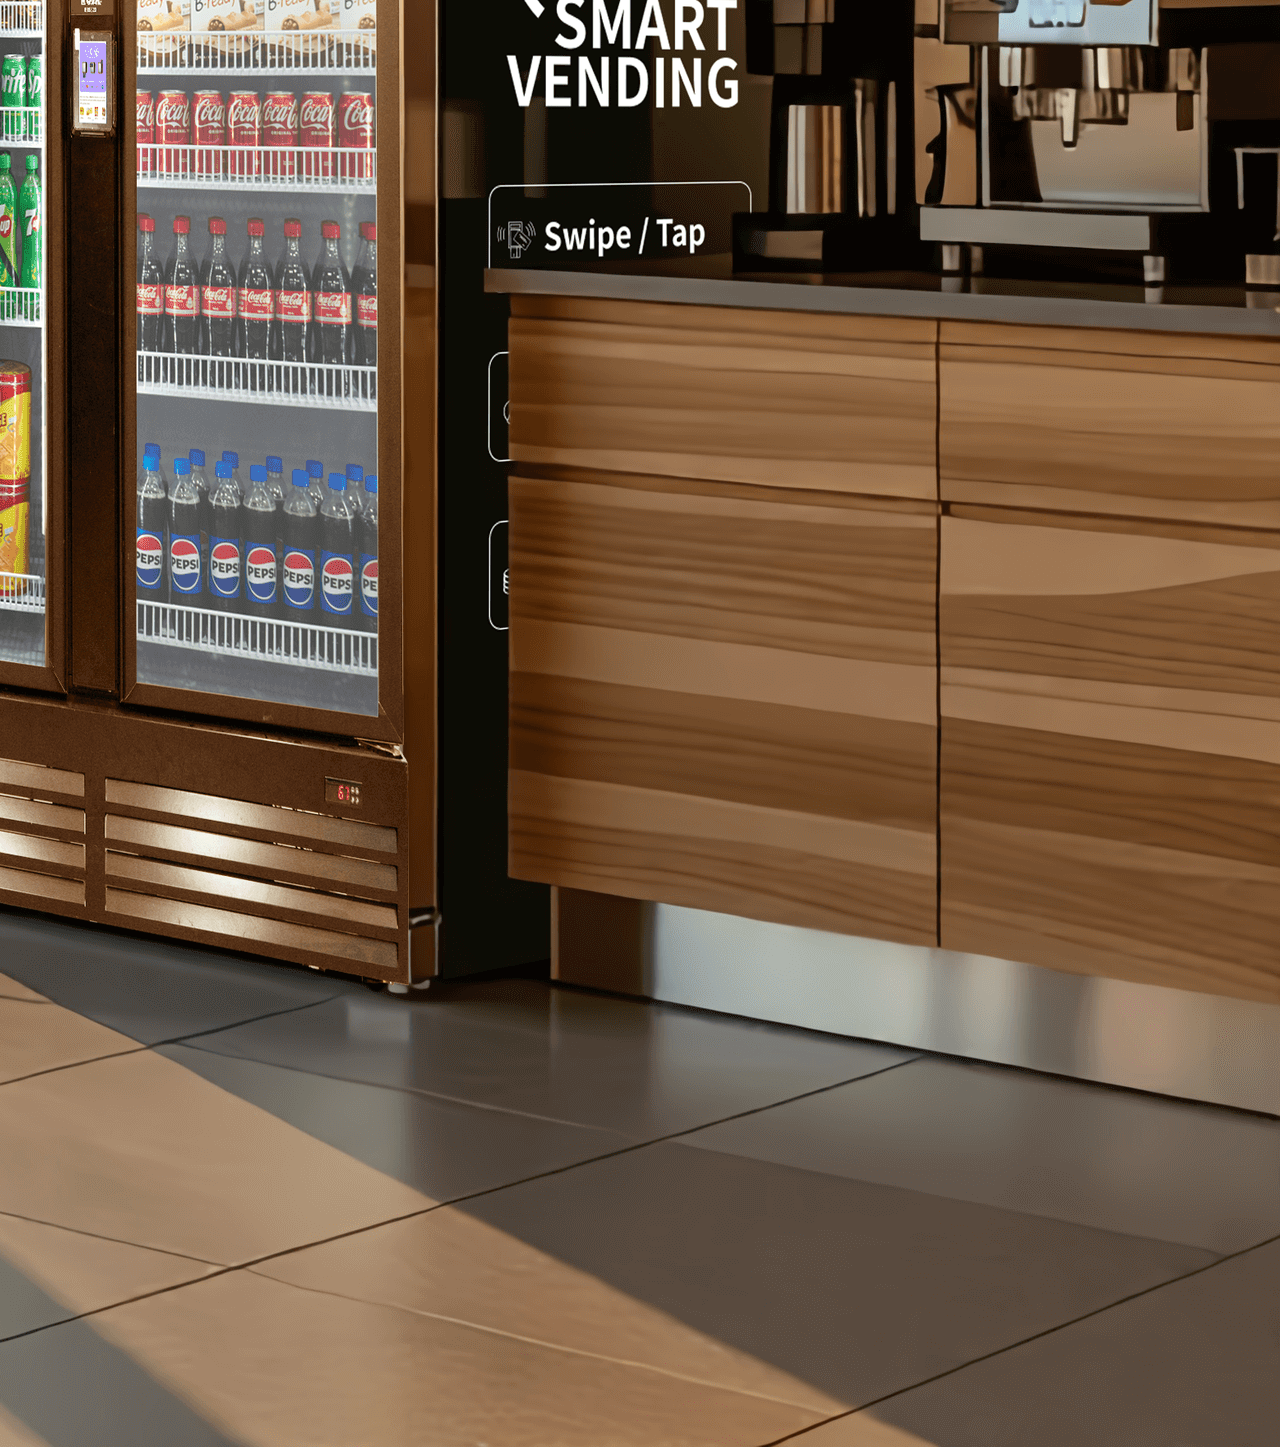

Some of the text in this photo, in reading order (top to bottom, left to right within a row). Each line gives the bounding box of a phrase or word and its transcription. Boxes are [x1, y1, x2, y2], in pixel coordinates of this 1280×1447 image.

[506, 55, 739, 109] VENDING
[544, 216, 705, 257] Swipe / Tap
